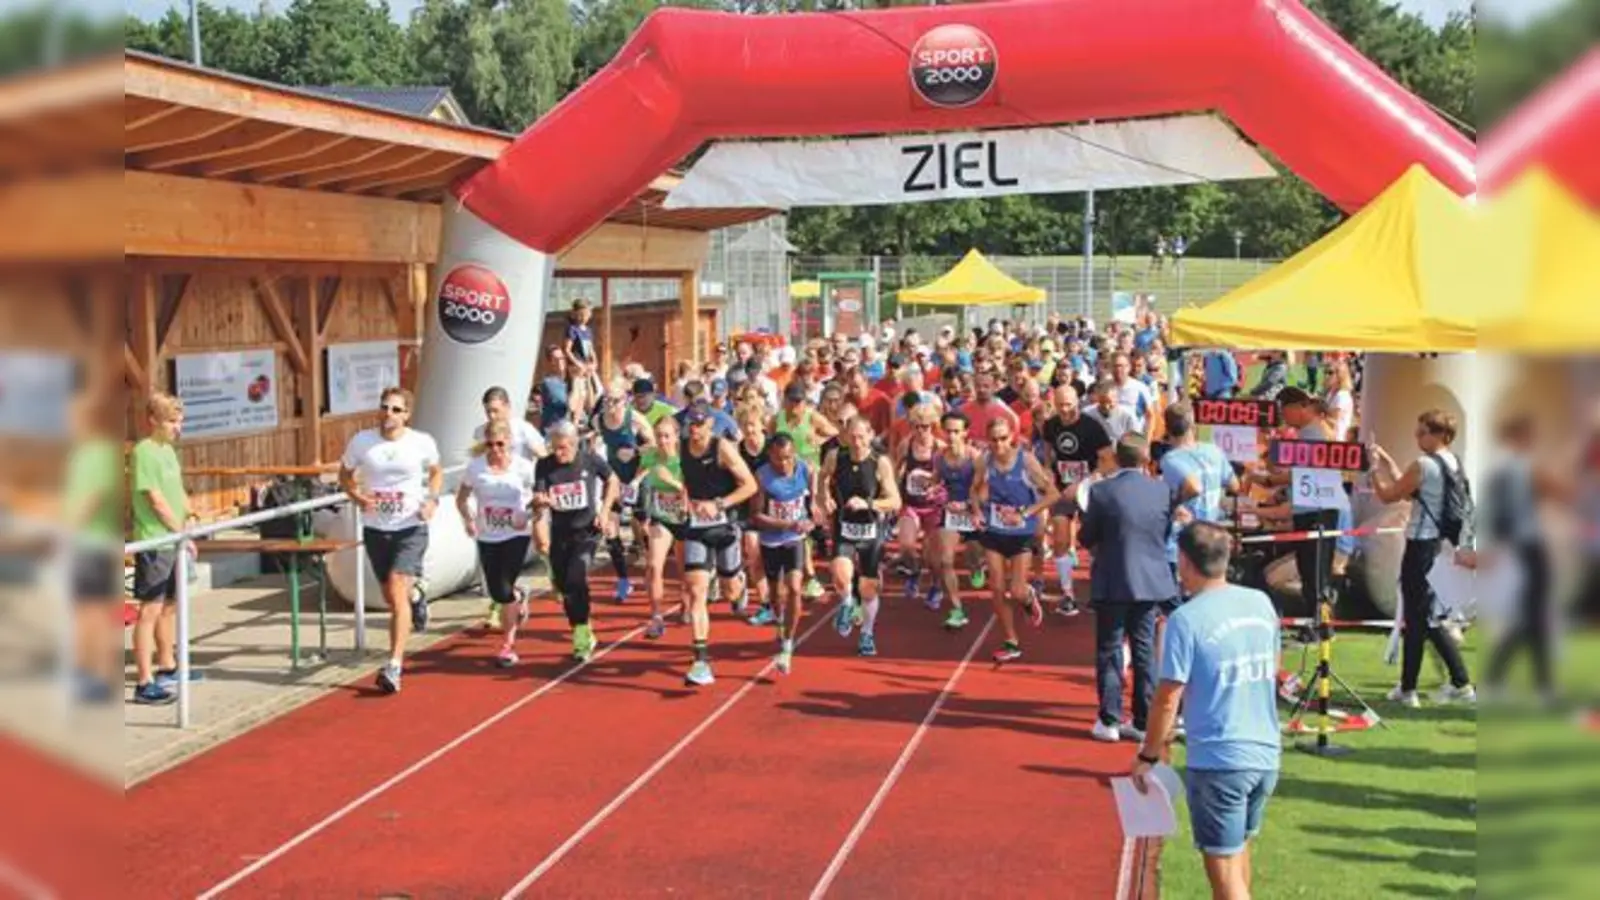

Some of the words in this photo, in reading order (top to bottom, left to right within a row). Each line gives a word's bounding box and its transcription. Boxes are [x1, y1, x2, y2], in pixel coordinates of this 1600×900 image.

[918, 47, 990, 67] SPORT
[925, 65, 983, 84] 2000
[902, 140, 1019, 192] ZIEL
[443, 283, 506, 310] SPORT
[443, 300, 496, 325] 2000
[1299, 473, 1312, 498] 5
